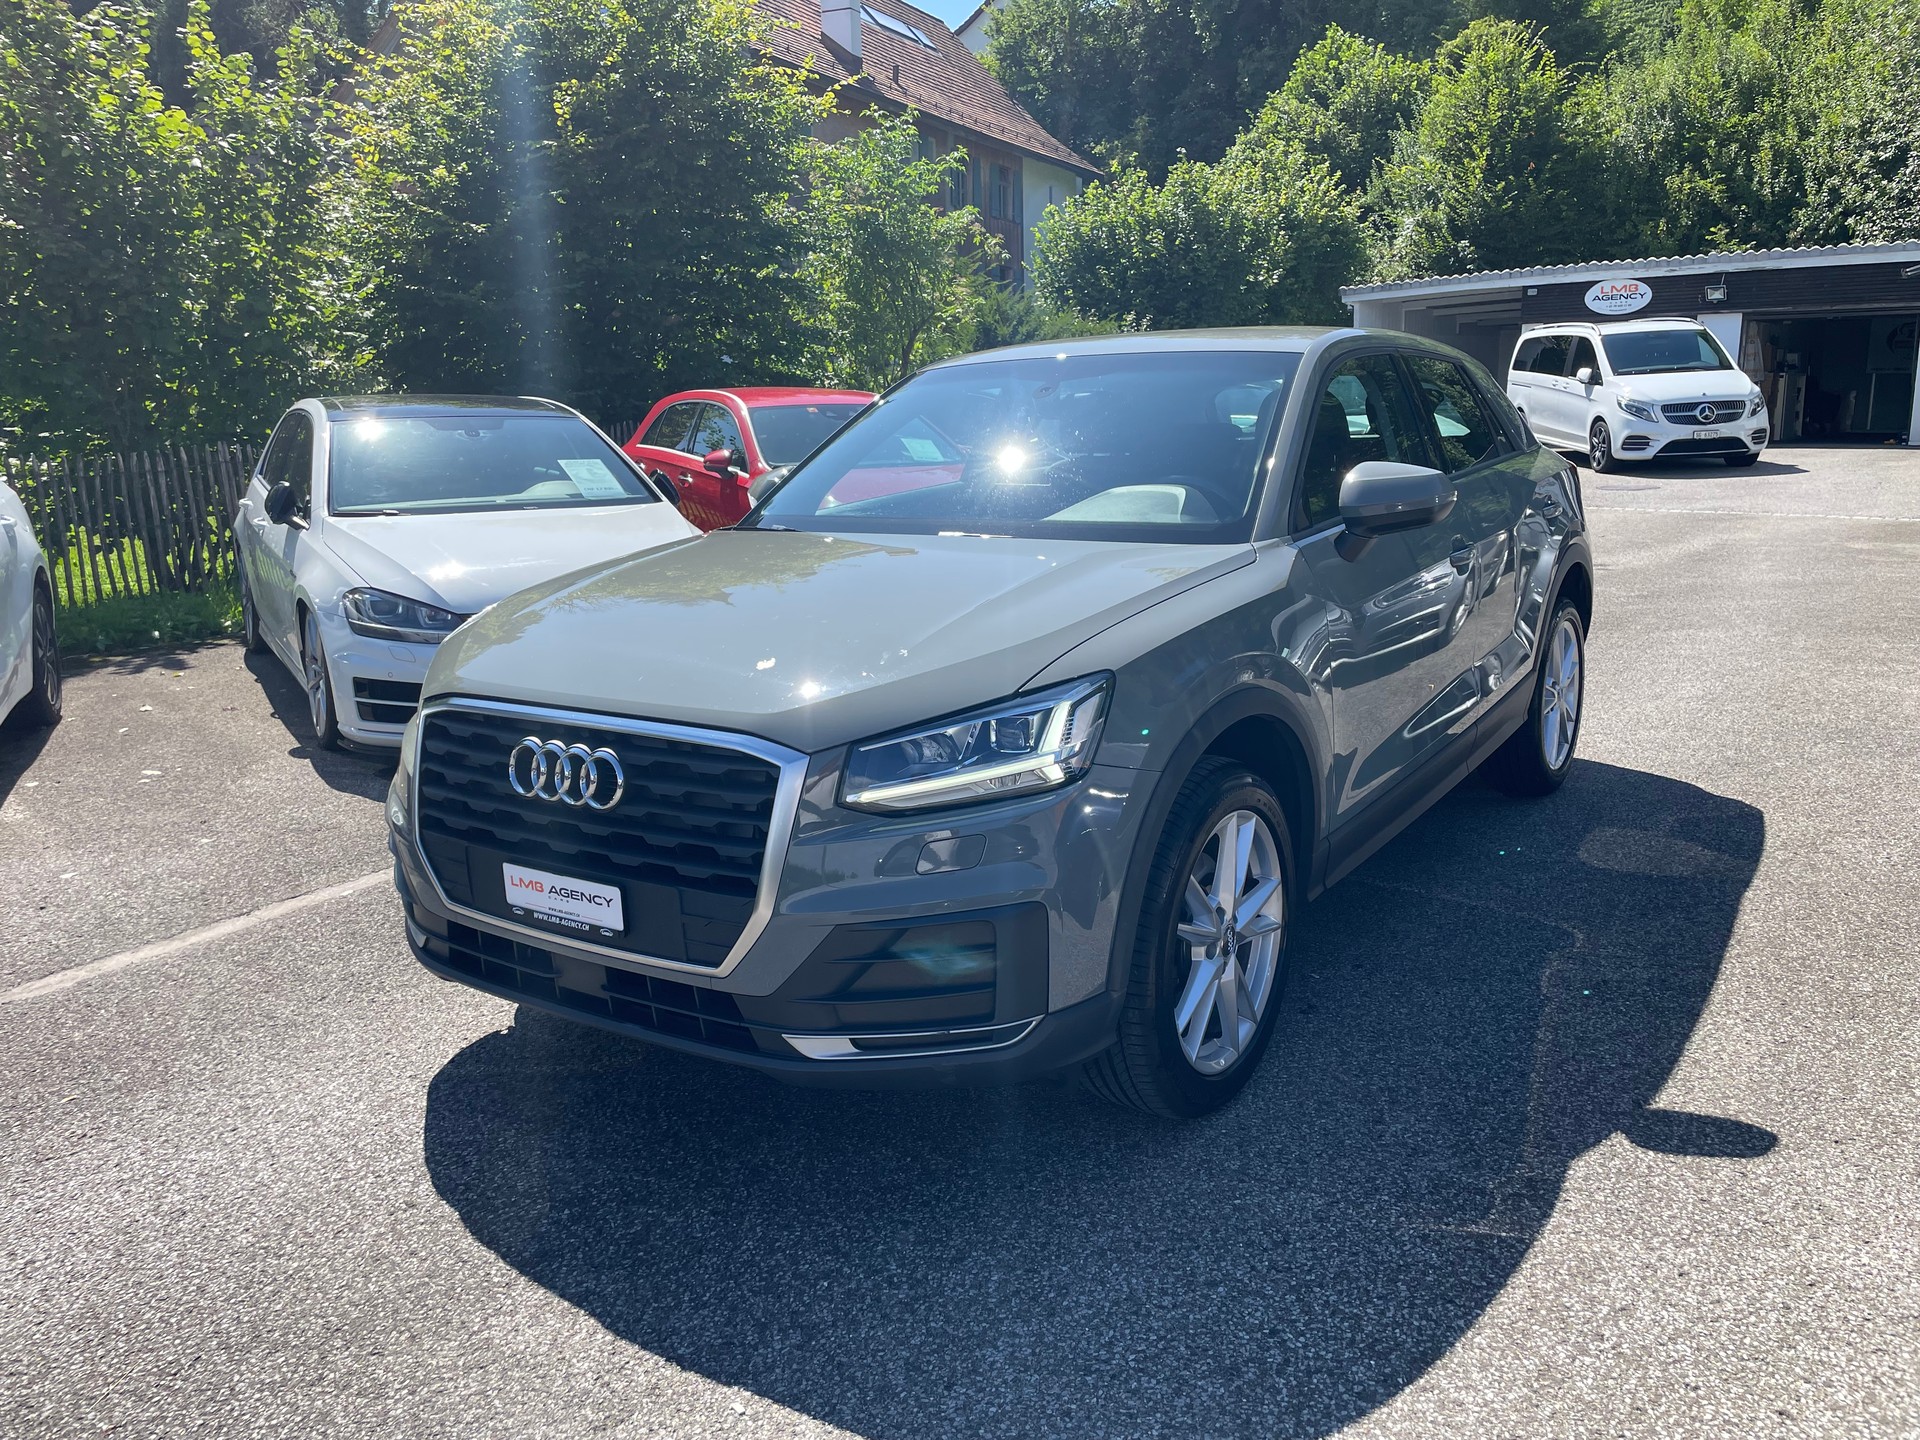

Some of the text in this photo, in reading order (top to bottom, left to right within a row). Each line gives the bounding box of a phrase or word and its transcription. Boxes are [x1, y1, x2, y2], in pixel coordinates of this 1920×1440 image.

[1600, 284, 1639, 294] LMB
[1592, 292, 1647, 302] AGENCY
[510, 875, 614, 907] LMB AGENCY
[533, 911, 590, 931] WWW.LMB-AGENCY.CH
